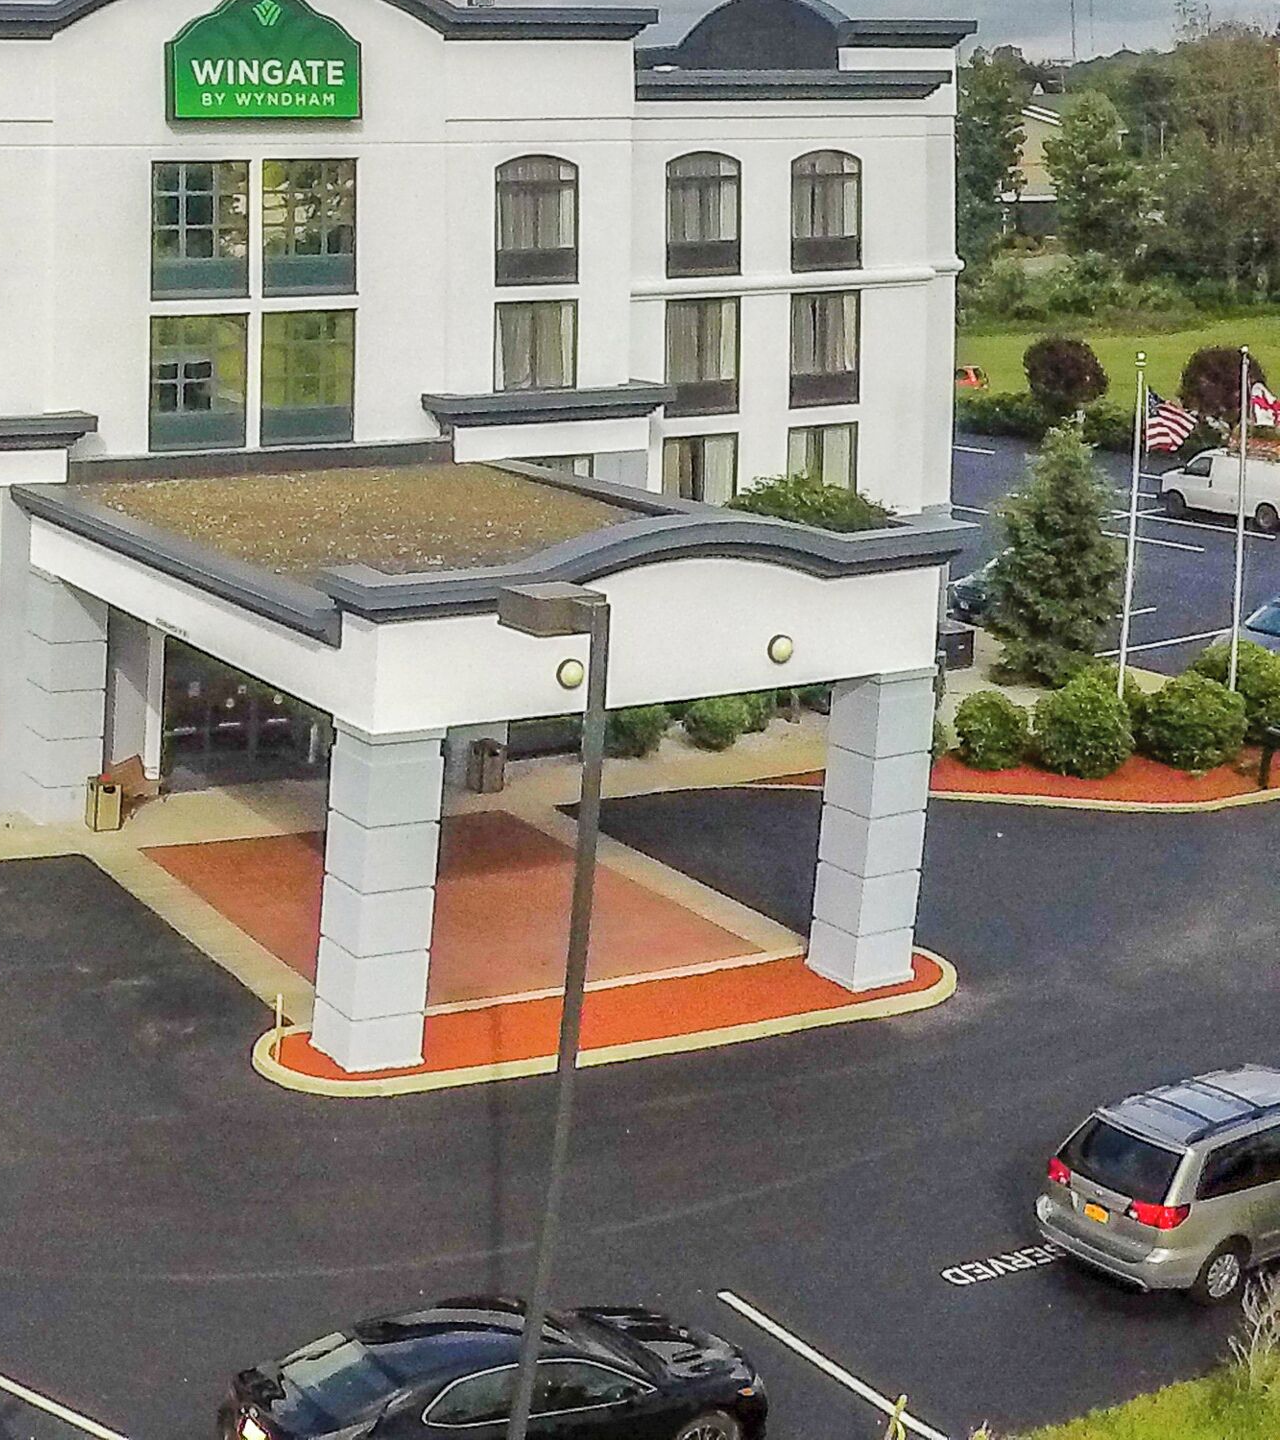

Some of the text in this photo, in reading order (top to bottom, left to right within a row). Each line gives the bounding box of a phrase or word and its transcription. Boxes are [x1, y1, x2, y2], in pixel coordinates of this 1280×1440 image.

[191, 60, 345, 85] WINGATE
[201, 93, 335, 106] BY WYNDHAM
